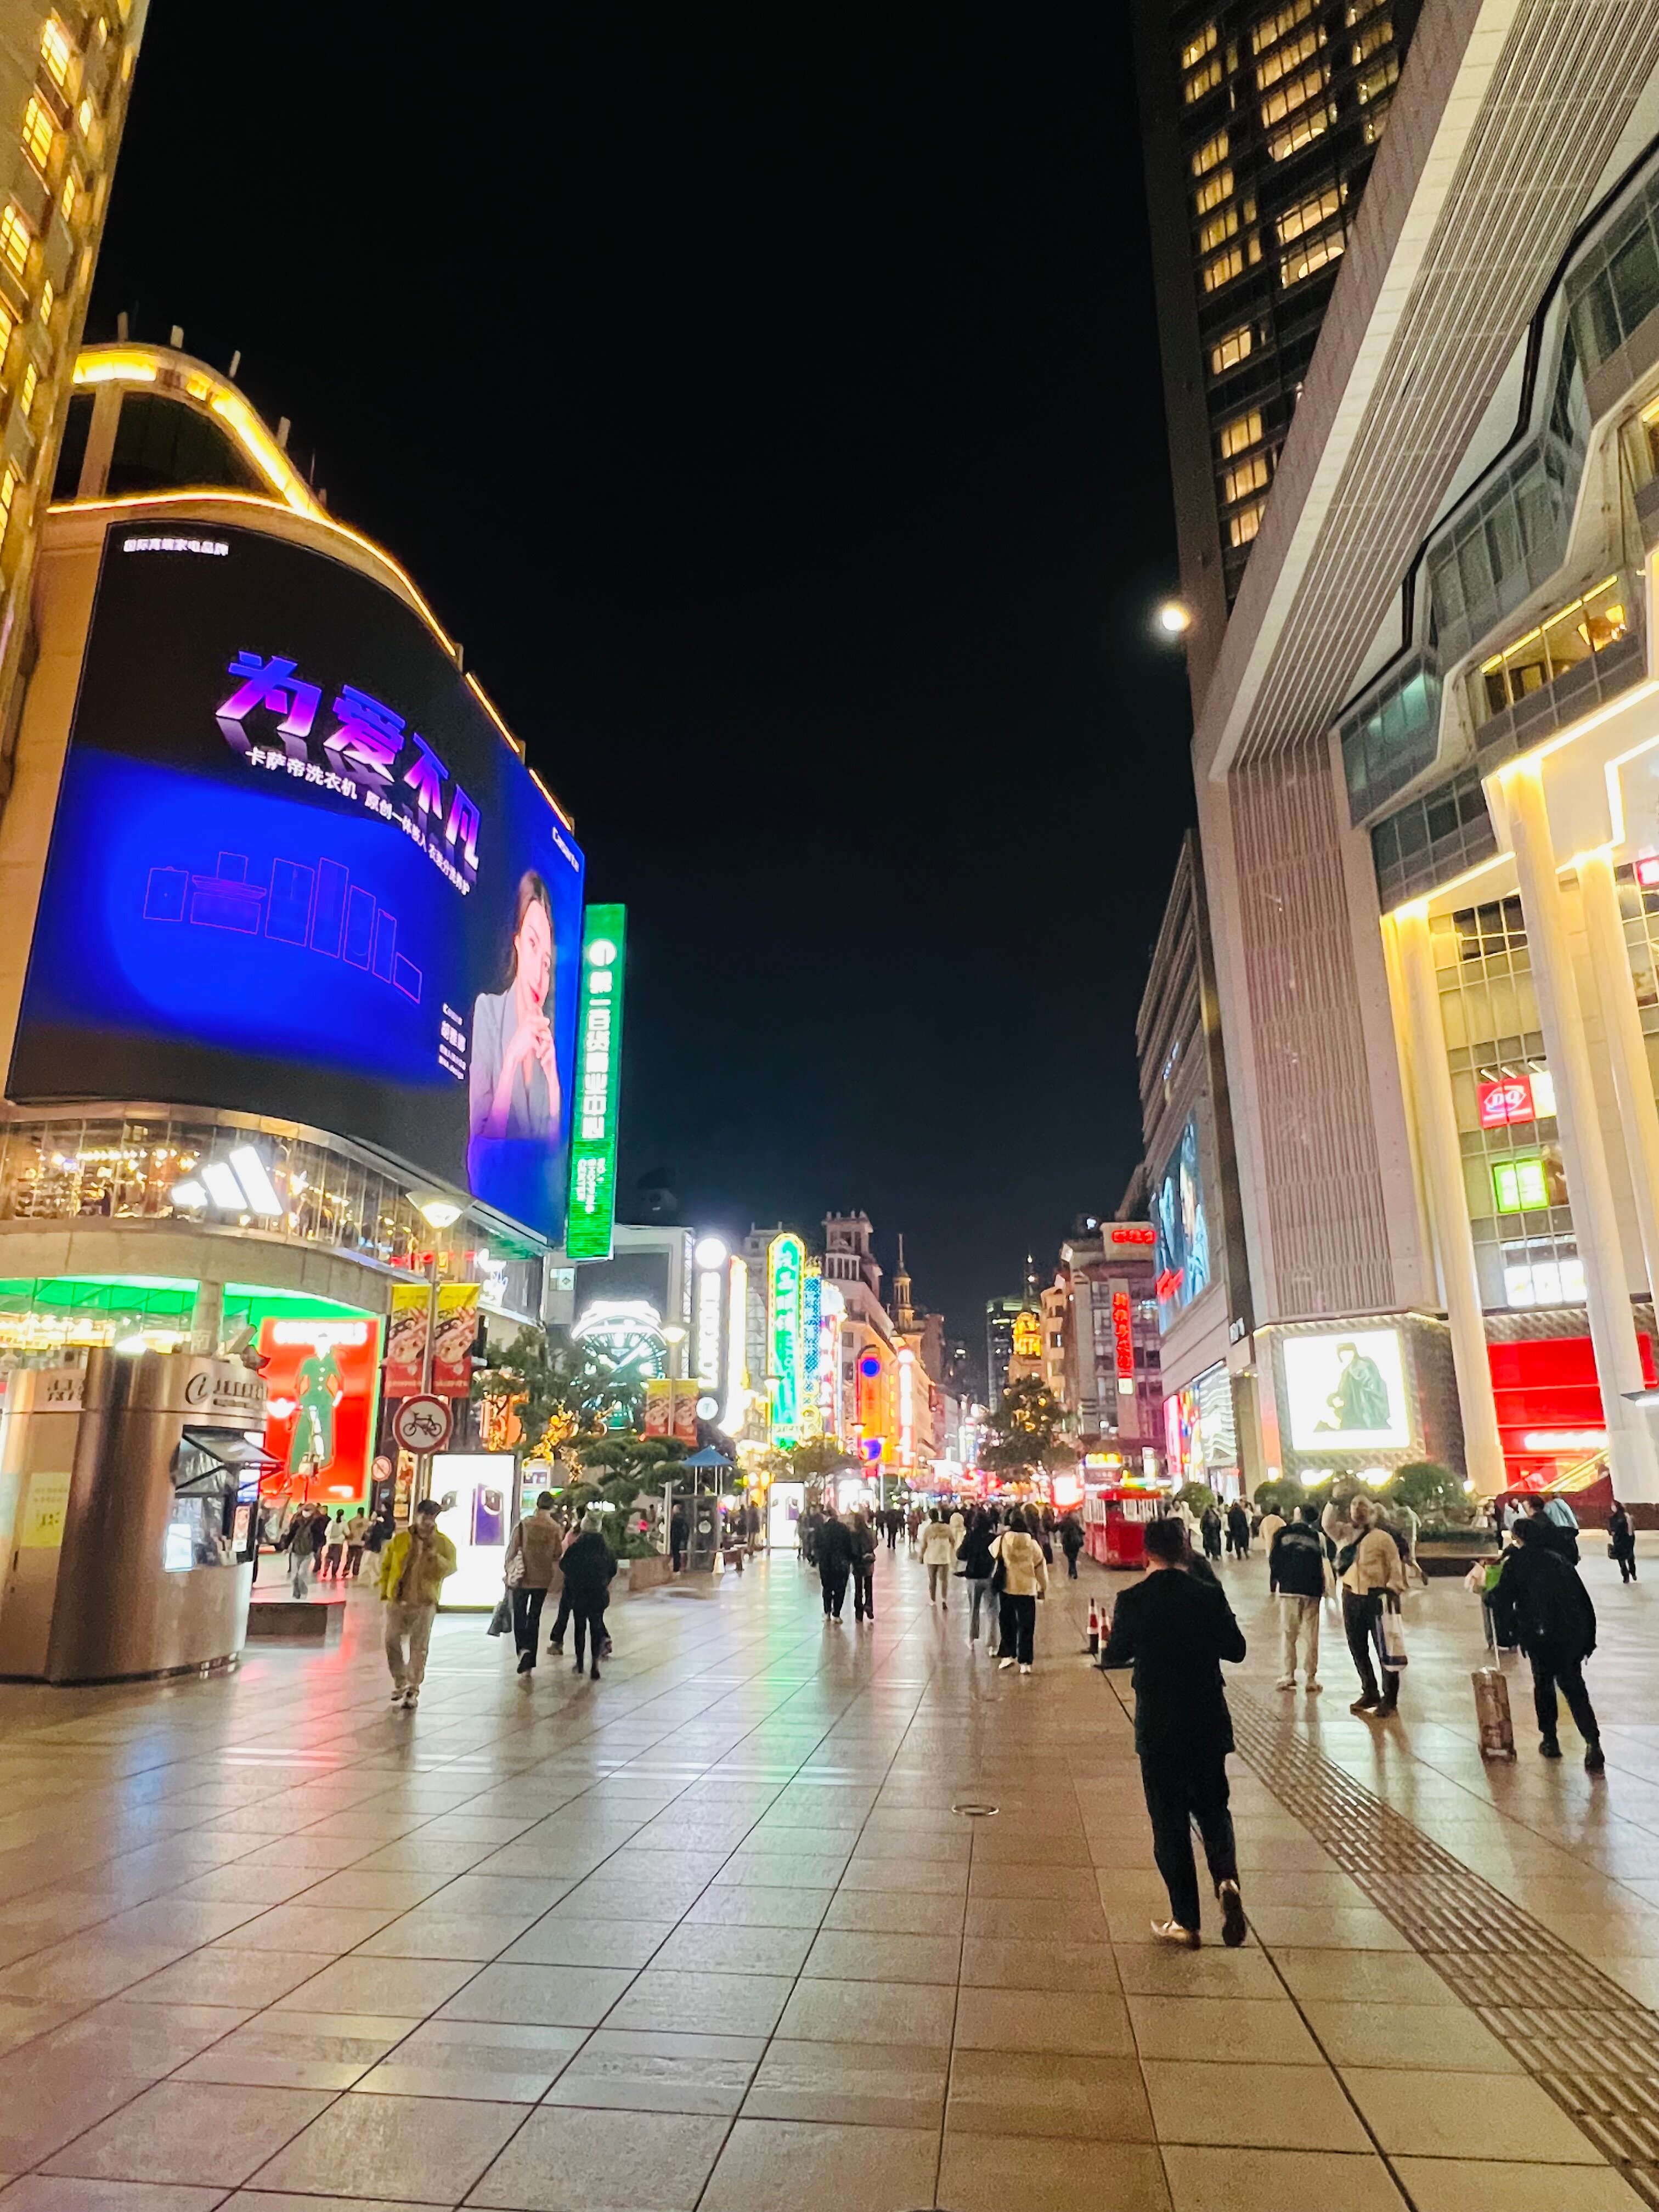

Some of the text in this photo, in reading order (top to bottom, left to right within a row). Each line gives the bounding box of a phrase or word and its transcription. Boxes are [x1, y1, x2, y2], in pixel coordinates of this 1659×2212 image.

[216, 651, 481, 870] 为爱不凡
[245, 746, 358, 800] 卡萨帝洗衣机
[1491, 1089, 1521, 1107] DQ
